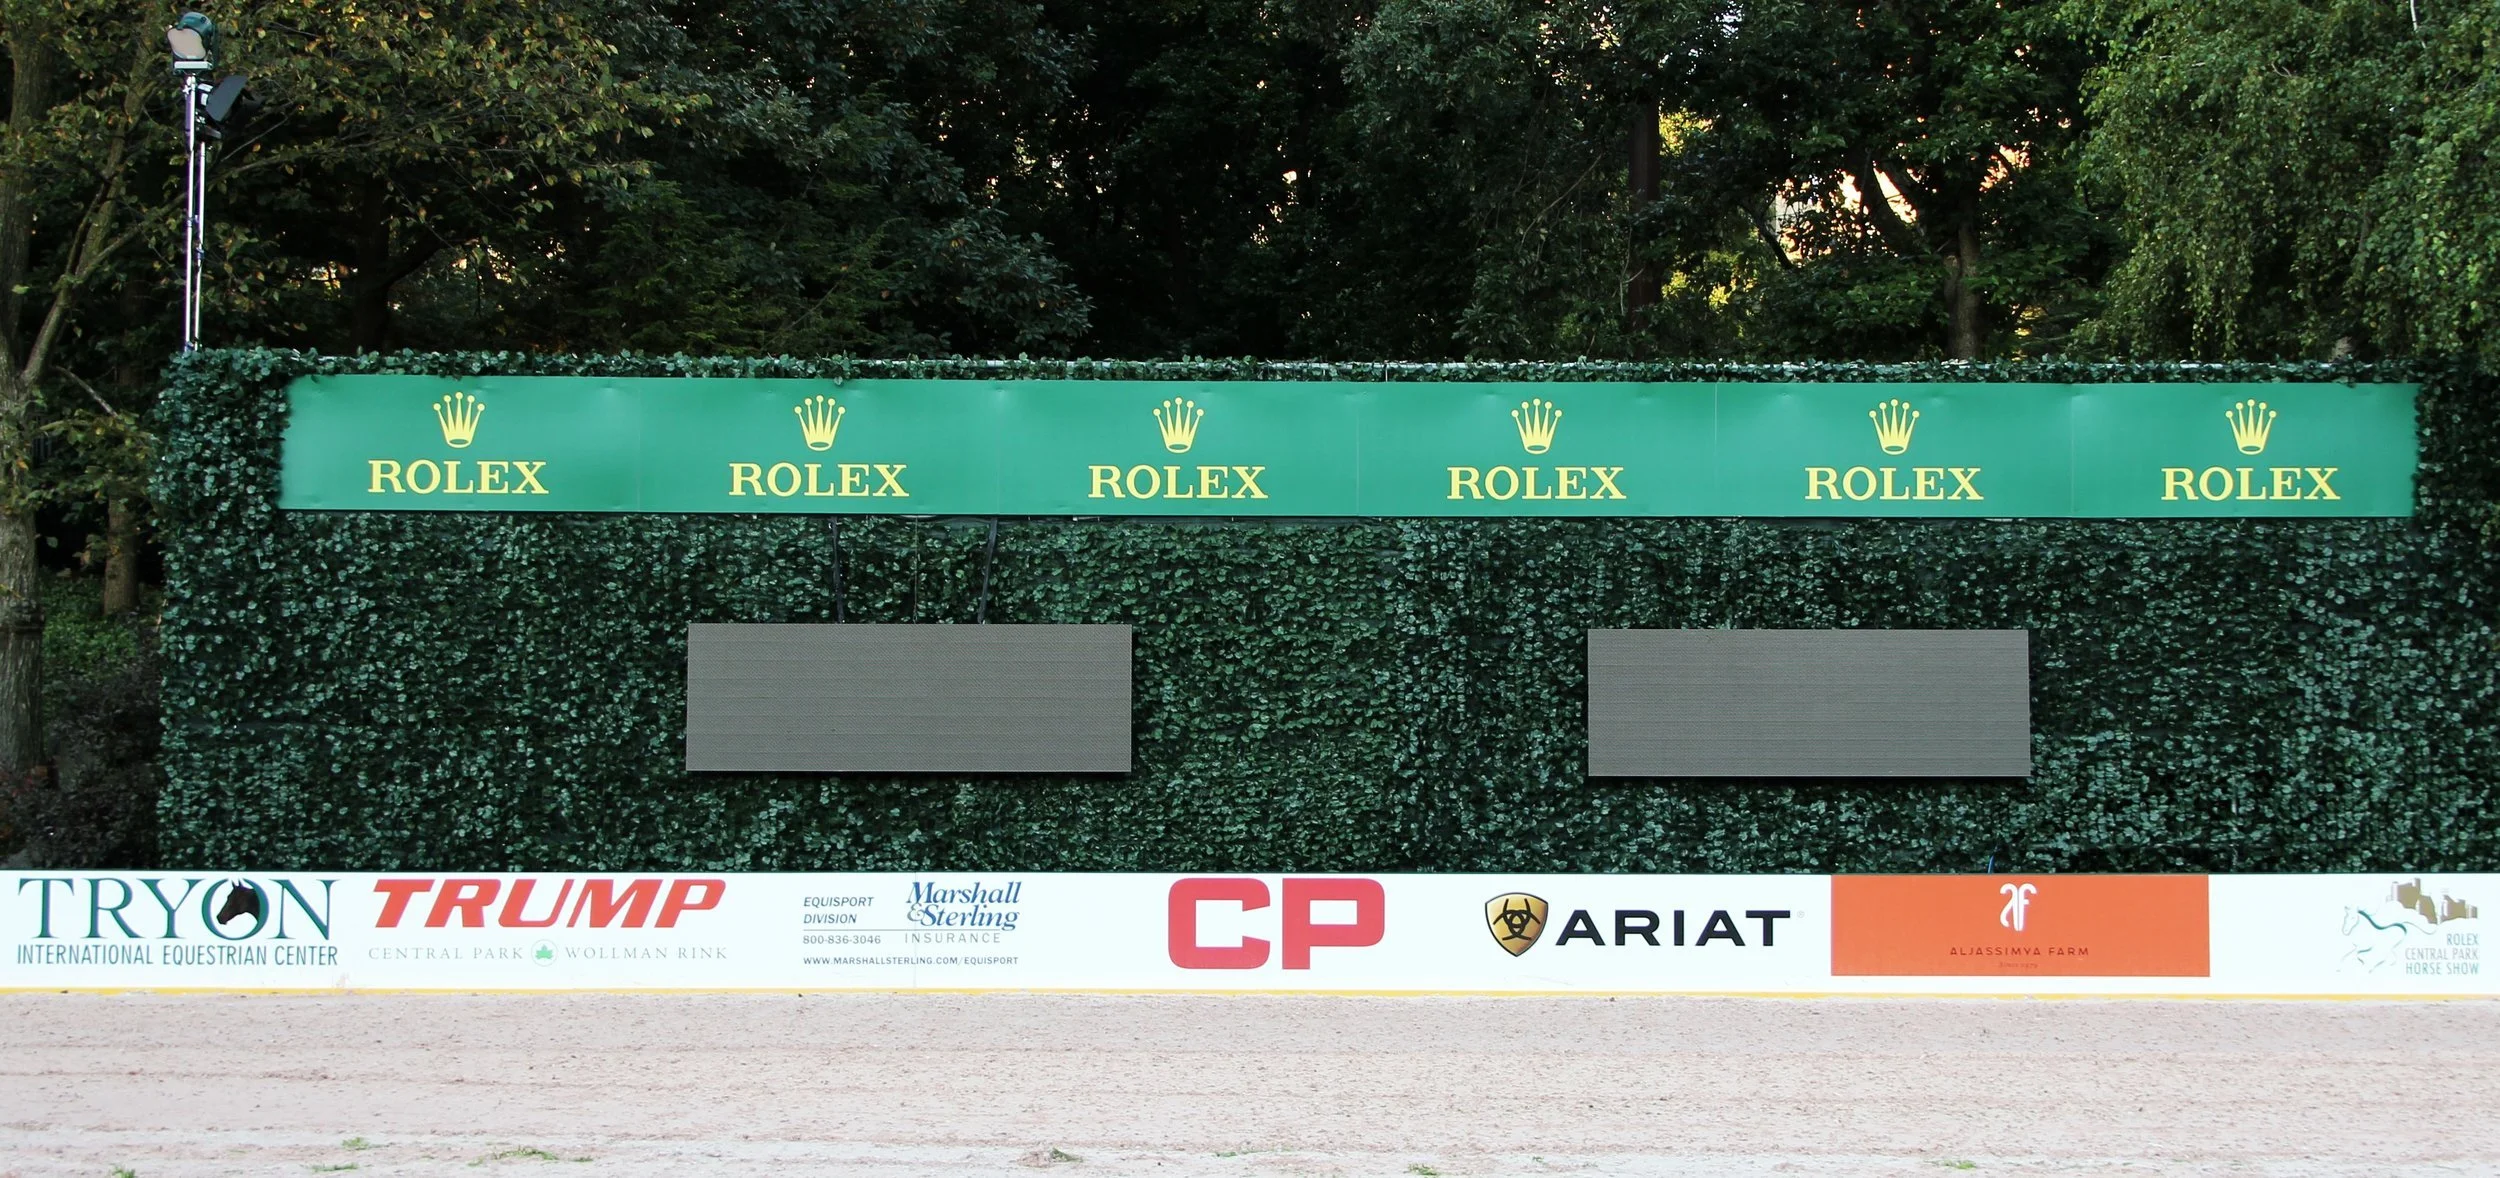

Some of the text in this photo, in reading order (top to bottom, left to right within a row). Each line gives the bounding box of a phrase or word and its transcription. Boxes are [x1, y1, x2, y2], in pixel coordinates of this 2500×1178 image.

[368, 459, 549, 495] ROLEX
[729, 462, 909, 497] ROLEX
[1088, 465, 1268, 499] ROLEX
[1447, 466, 1626, 500] ROLEX
[1805, 467, 1984, 500] ROLEX
[2161, 467, 2341, 500] ROLEX
[373, 879, 727, 928] TRUMP
[803, 896, 874, 908] EQUISPORT
[906, 881, 1022, 904] Marshall
[18, 877, 341, 940] TRYON
[803, 914, 857, 924] DIVISION
[1168, 878, 1384, 969] CP
[1555, 909, 1791, 947] ARIAT
[802, 935, 882, 945] 800-836-3046
[904, 933, 1001, 944] INSURANCE
[2446, 933, 2479, 946] ROLEX
[17, 944, 338, 966] INTERNATIONAL EQUESTRIAN CENTER
[368, 947, 728, 960] CENTRAL PARK WOLLMAN RINK
[803, 956, 1019, 966] WWW.MARSHALLSTERLING.COM/EQUISPORT
[1949, 947, 2089, 956] ALJASSIMYA FARM
[2405, 948, 2479, 960] CENTRAL PARK
[2406, 963, 2480, 975] HORSE SHOW
